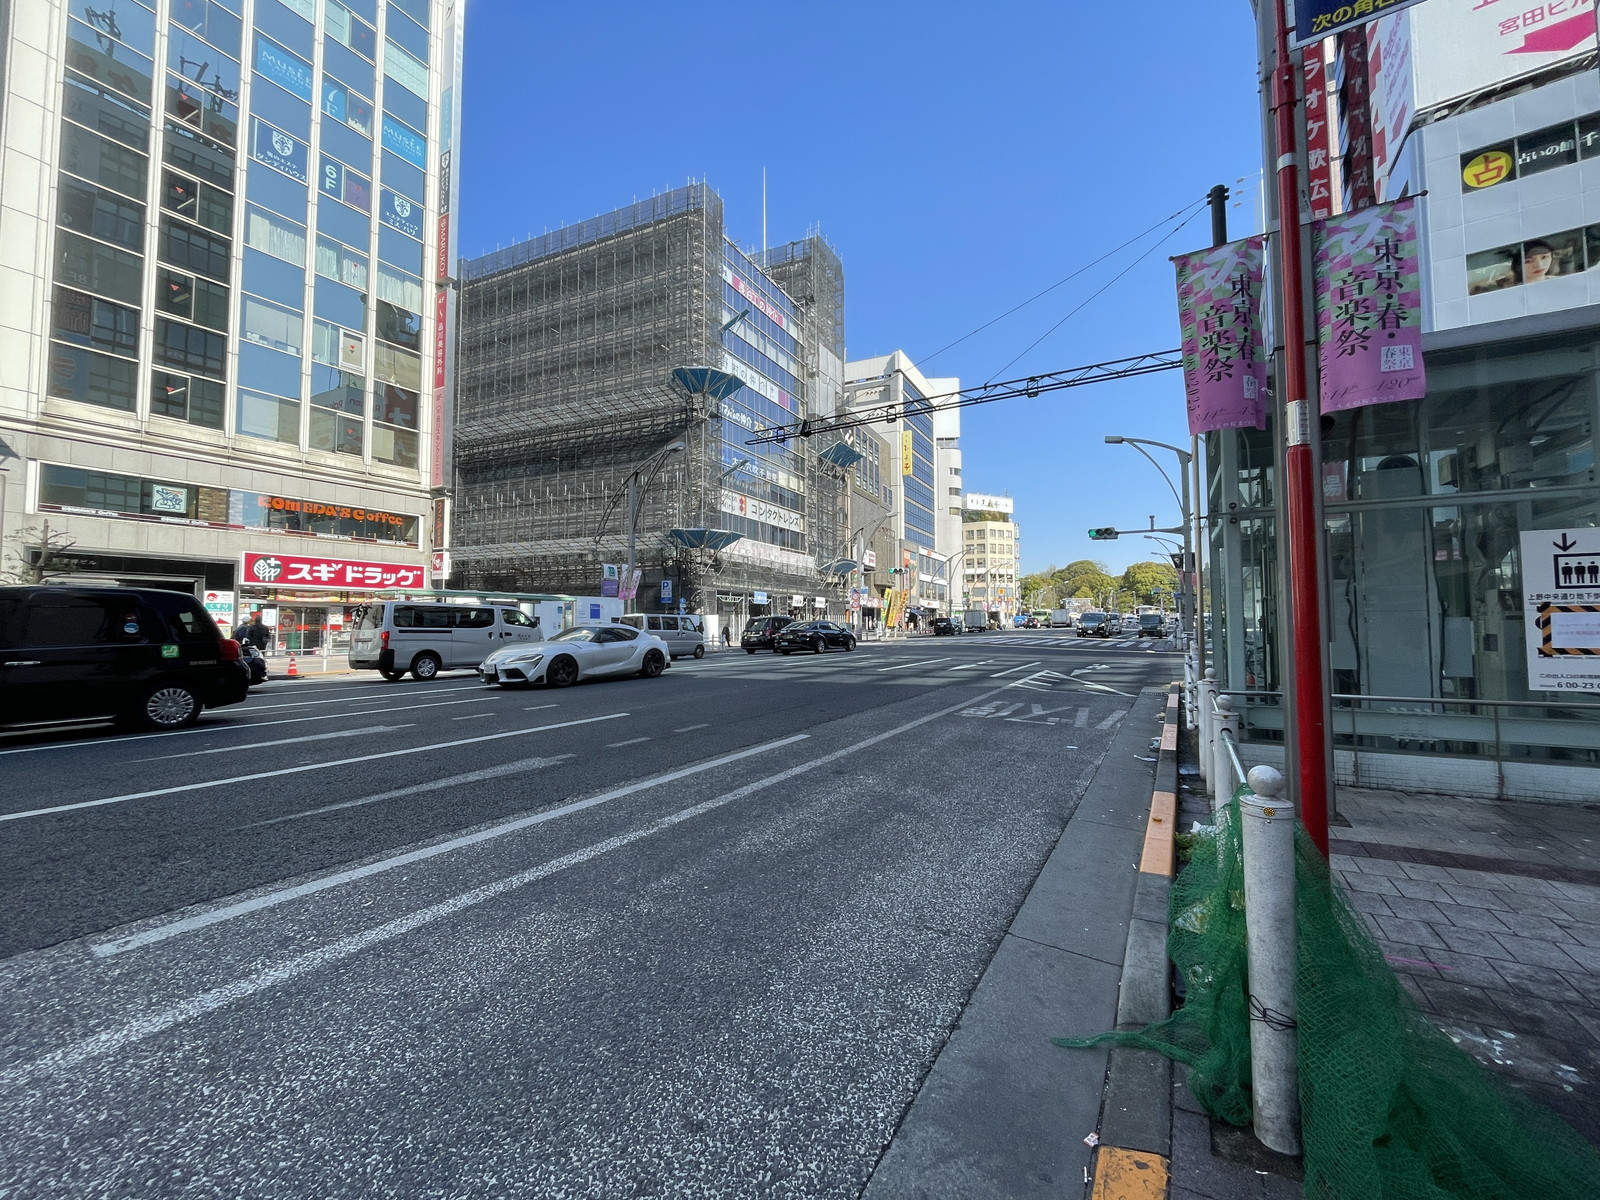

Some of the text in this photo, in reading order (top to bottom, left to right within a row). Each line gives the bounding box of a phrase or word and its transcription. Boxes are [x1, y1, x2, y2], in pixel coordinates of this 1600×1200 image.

[327, 89, 338, 115] 7F
[1303, 43, 1329, 220] ラオケ歌広
[256, 152, 307, 182] ダンディハウス
[325, 164, 337, 190] 6F
[1473, 154, 1504, 185] 占
[1336, 271, 1372, 360] 音楽祭
[1200, 304, 1235, 384] 音楽祭
[1187, 382, 1200, 412] 2025
[751, 504, 800, 527] コンタクトレンズ
[288, 563, 421, 586] スギ ドラッグ
[663, 582, 669, 590] P
